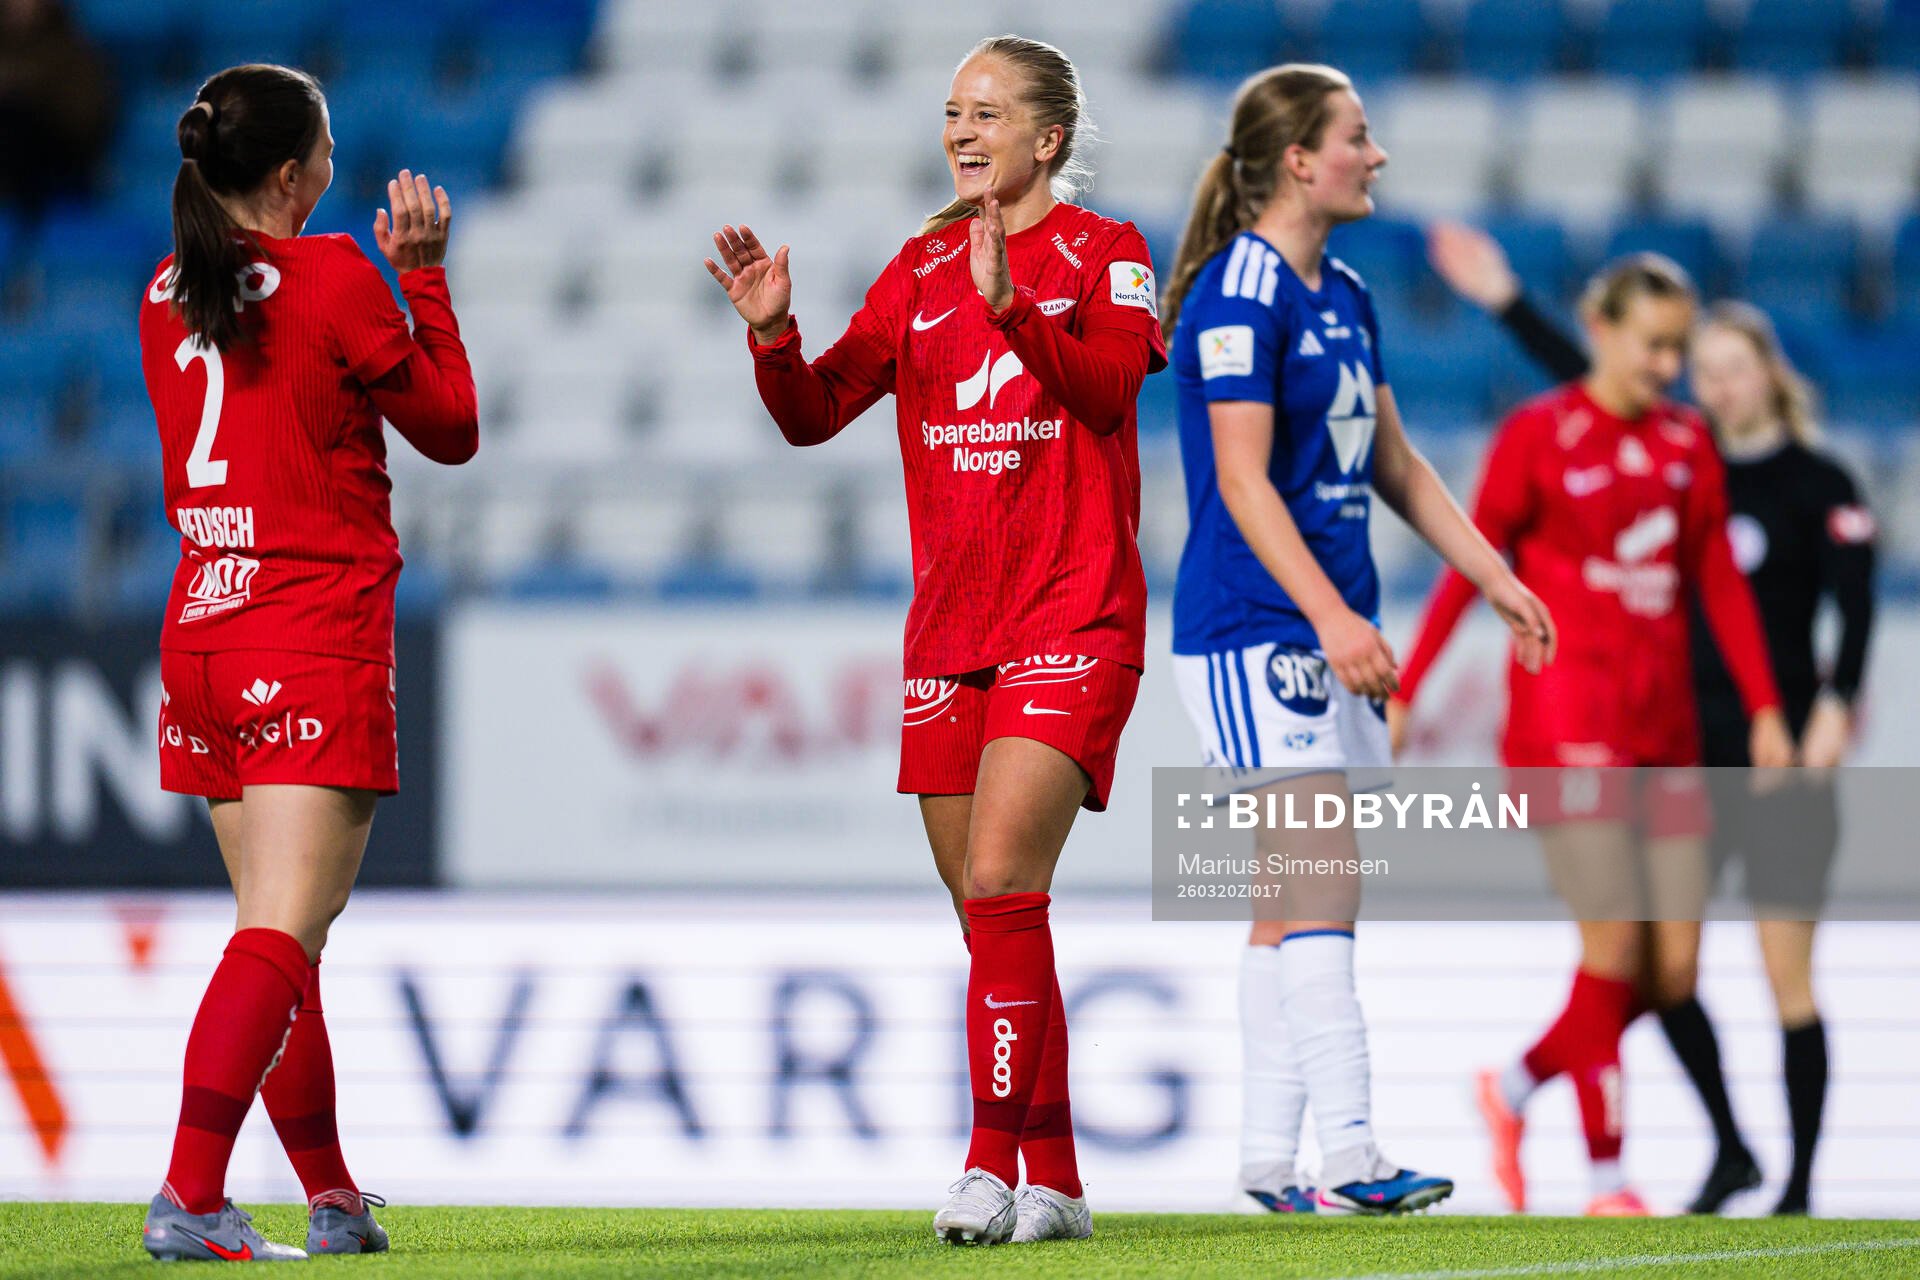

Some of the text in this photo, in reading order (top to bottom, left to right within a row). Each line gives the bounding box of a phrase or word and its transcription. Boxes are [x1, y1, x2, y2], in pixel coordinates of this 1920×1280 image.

[1114, 292, 1140, 302] Norsk
[173, 332, 229, 489] 2
[953, 447, 1021, 476] Norge
[177, 506, 255, 548] REDISCH
[992, 1018, 1018, 1098] coop
